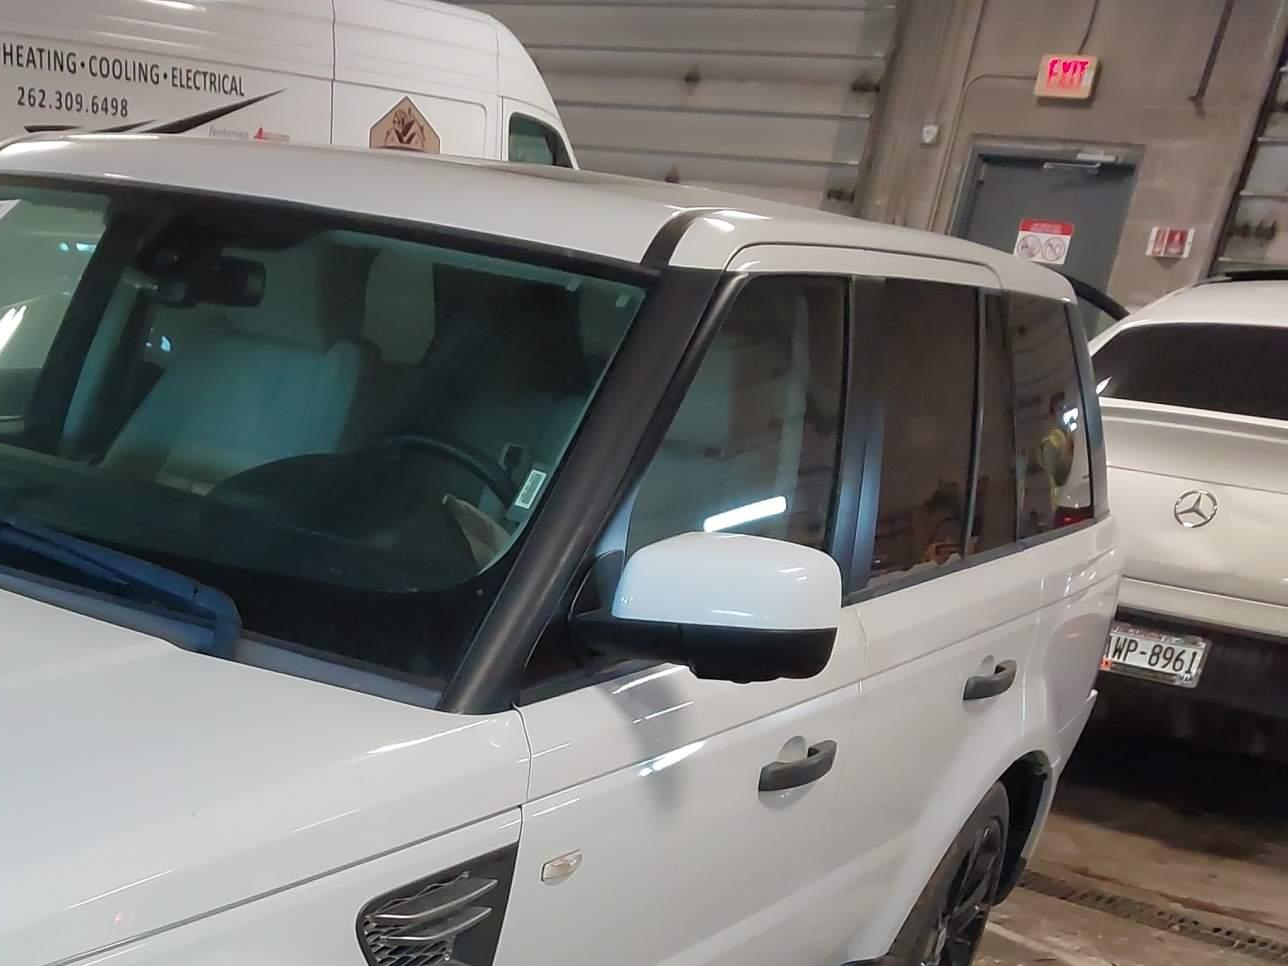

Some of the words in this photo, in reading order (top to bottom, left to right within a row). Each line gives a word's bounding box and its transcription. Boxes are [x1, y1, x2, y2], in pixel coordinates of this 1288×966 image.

[2, 43, 77, 74] HEATING
[88, 55, 160, 85] COOLING
[171, 67, 245, 97] ELECTRICAL
[1047, 58, 1089, 88] EXIT
[17, 86, 129, 118] 262.309.6498
